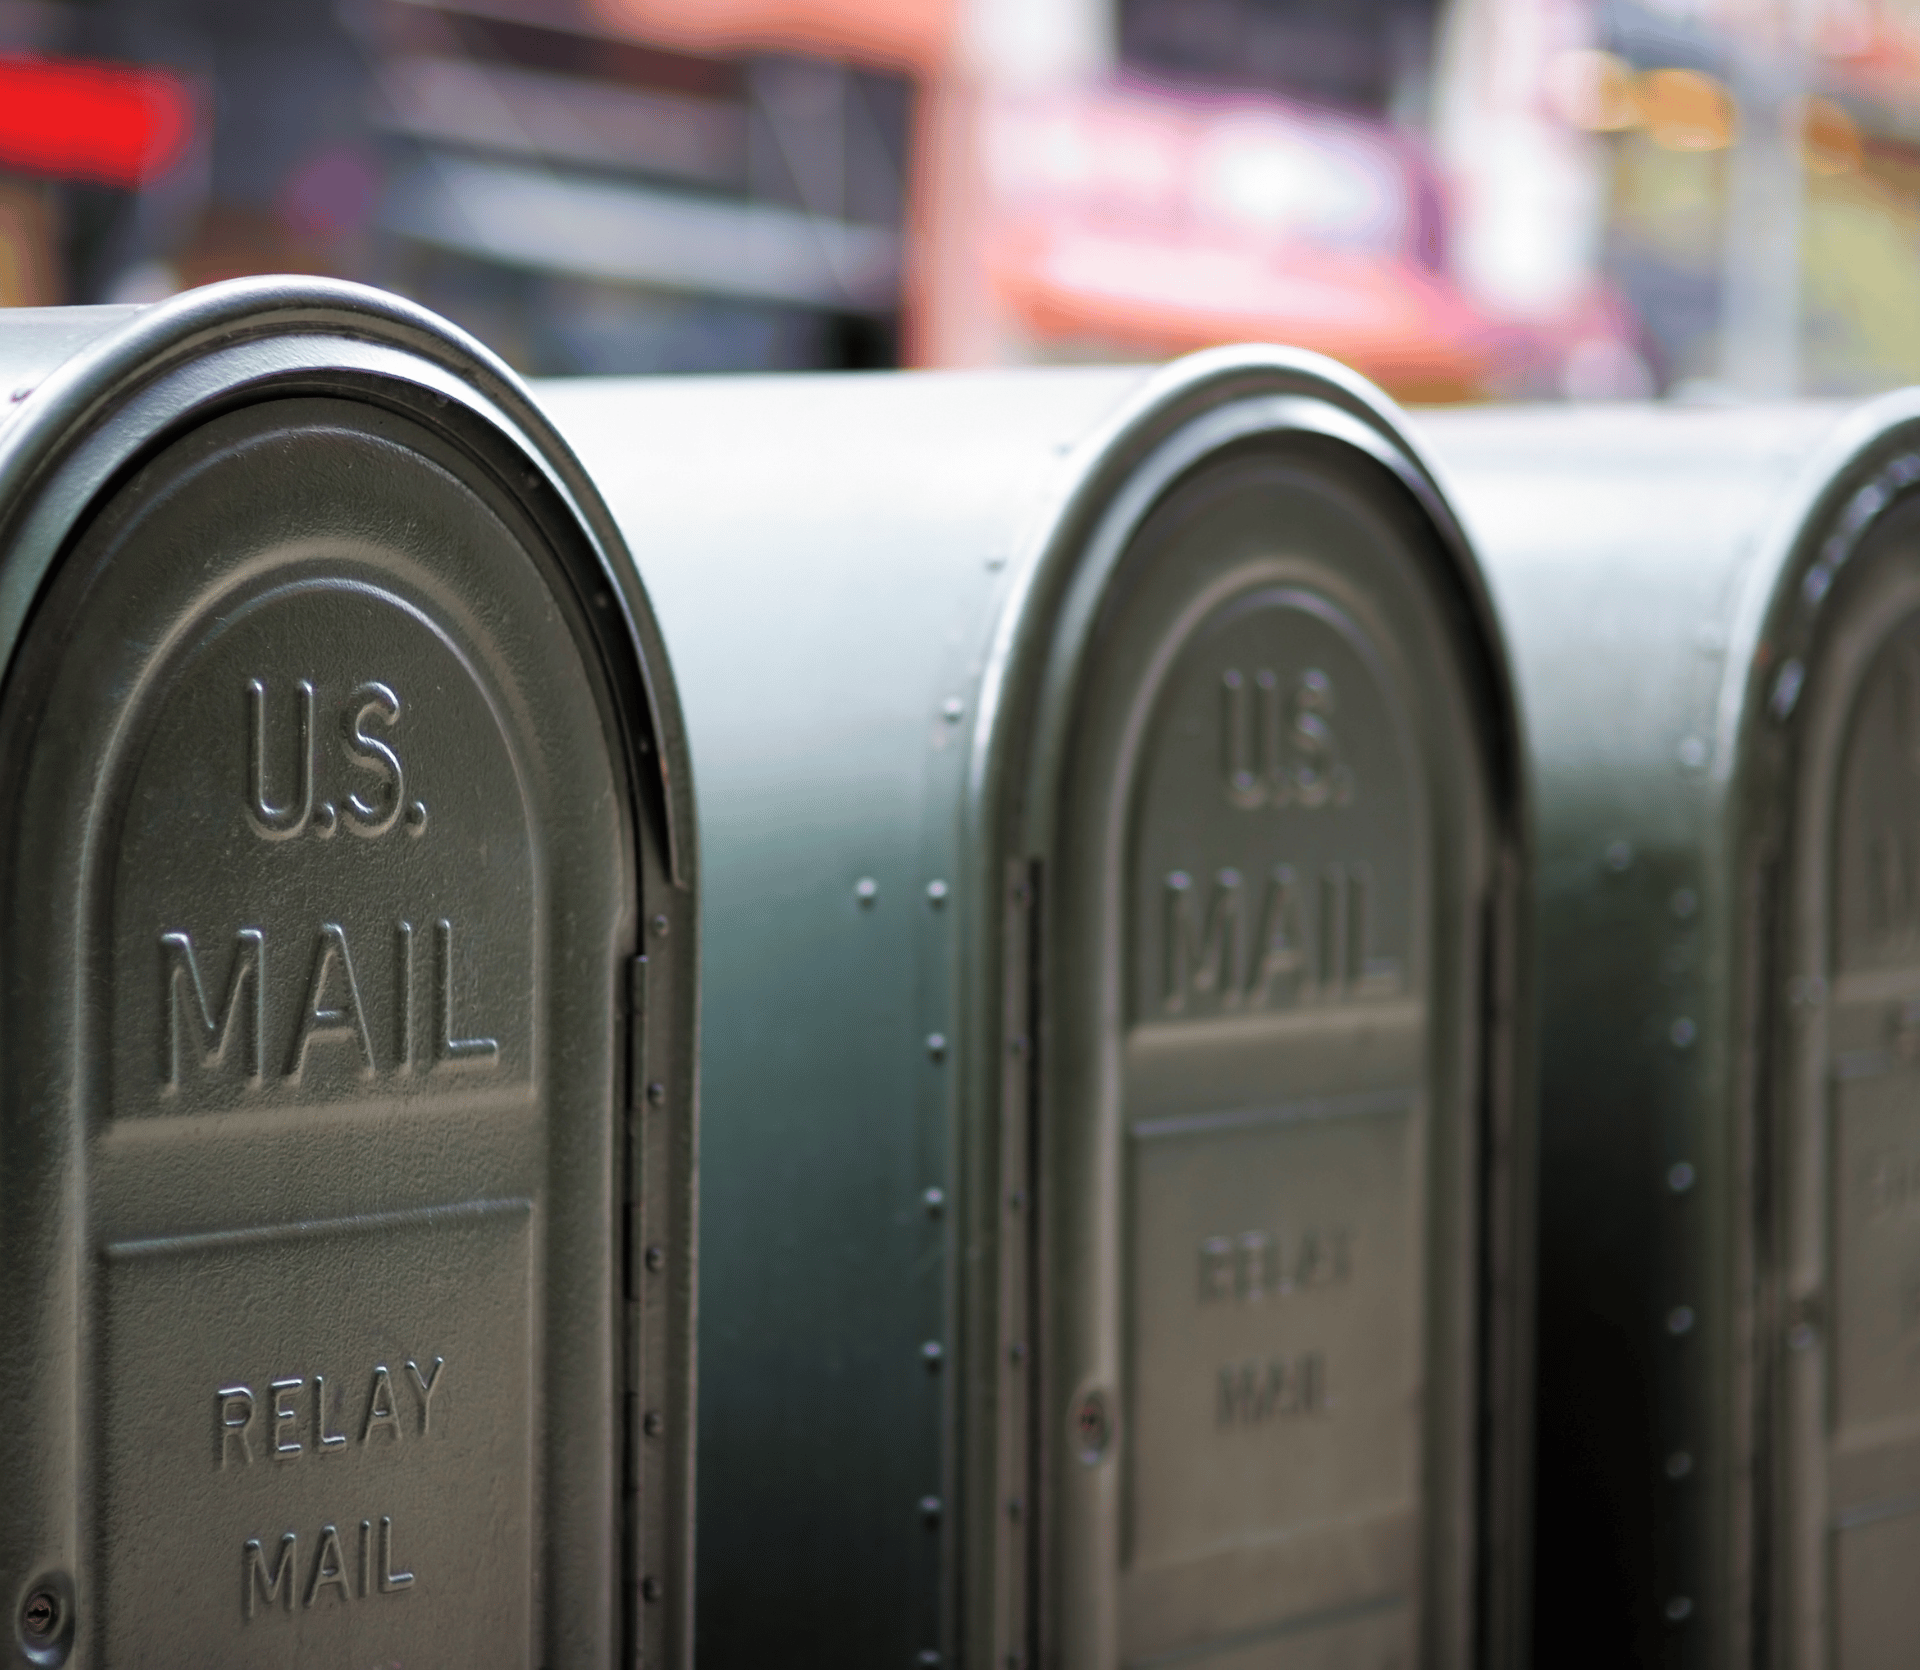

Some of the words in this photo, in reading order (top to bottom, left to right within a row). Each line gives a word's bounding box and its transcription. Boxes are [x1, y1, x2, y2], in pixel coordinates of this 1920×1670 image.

[245, 677, 427, 841] U.S.
[160, 918, 498, 1098] MAIL
[1163, 860, 1402, 1011] MAIL
[215, 1356, 444, 1470] RELAY
[244, 1516, 414, 1622] MAIL
